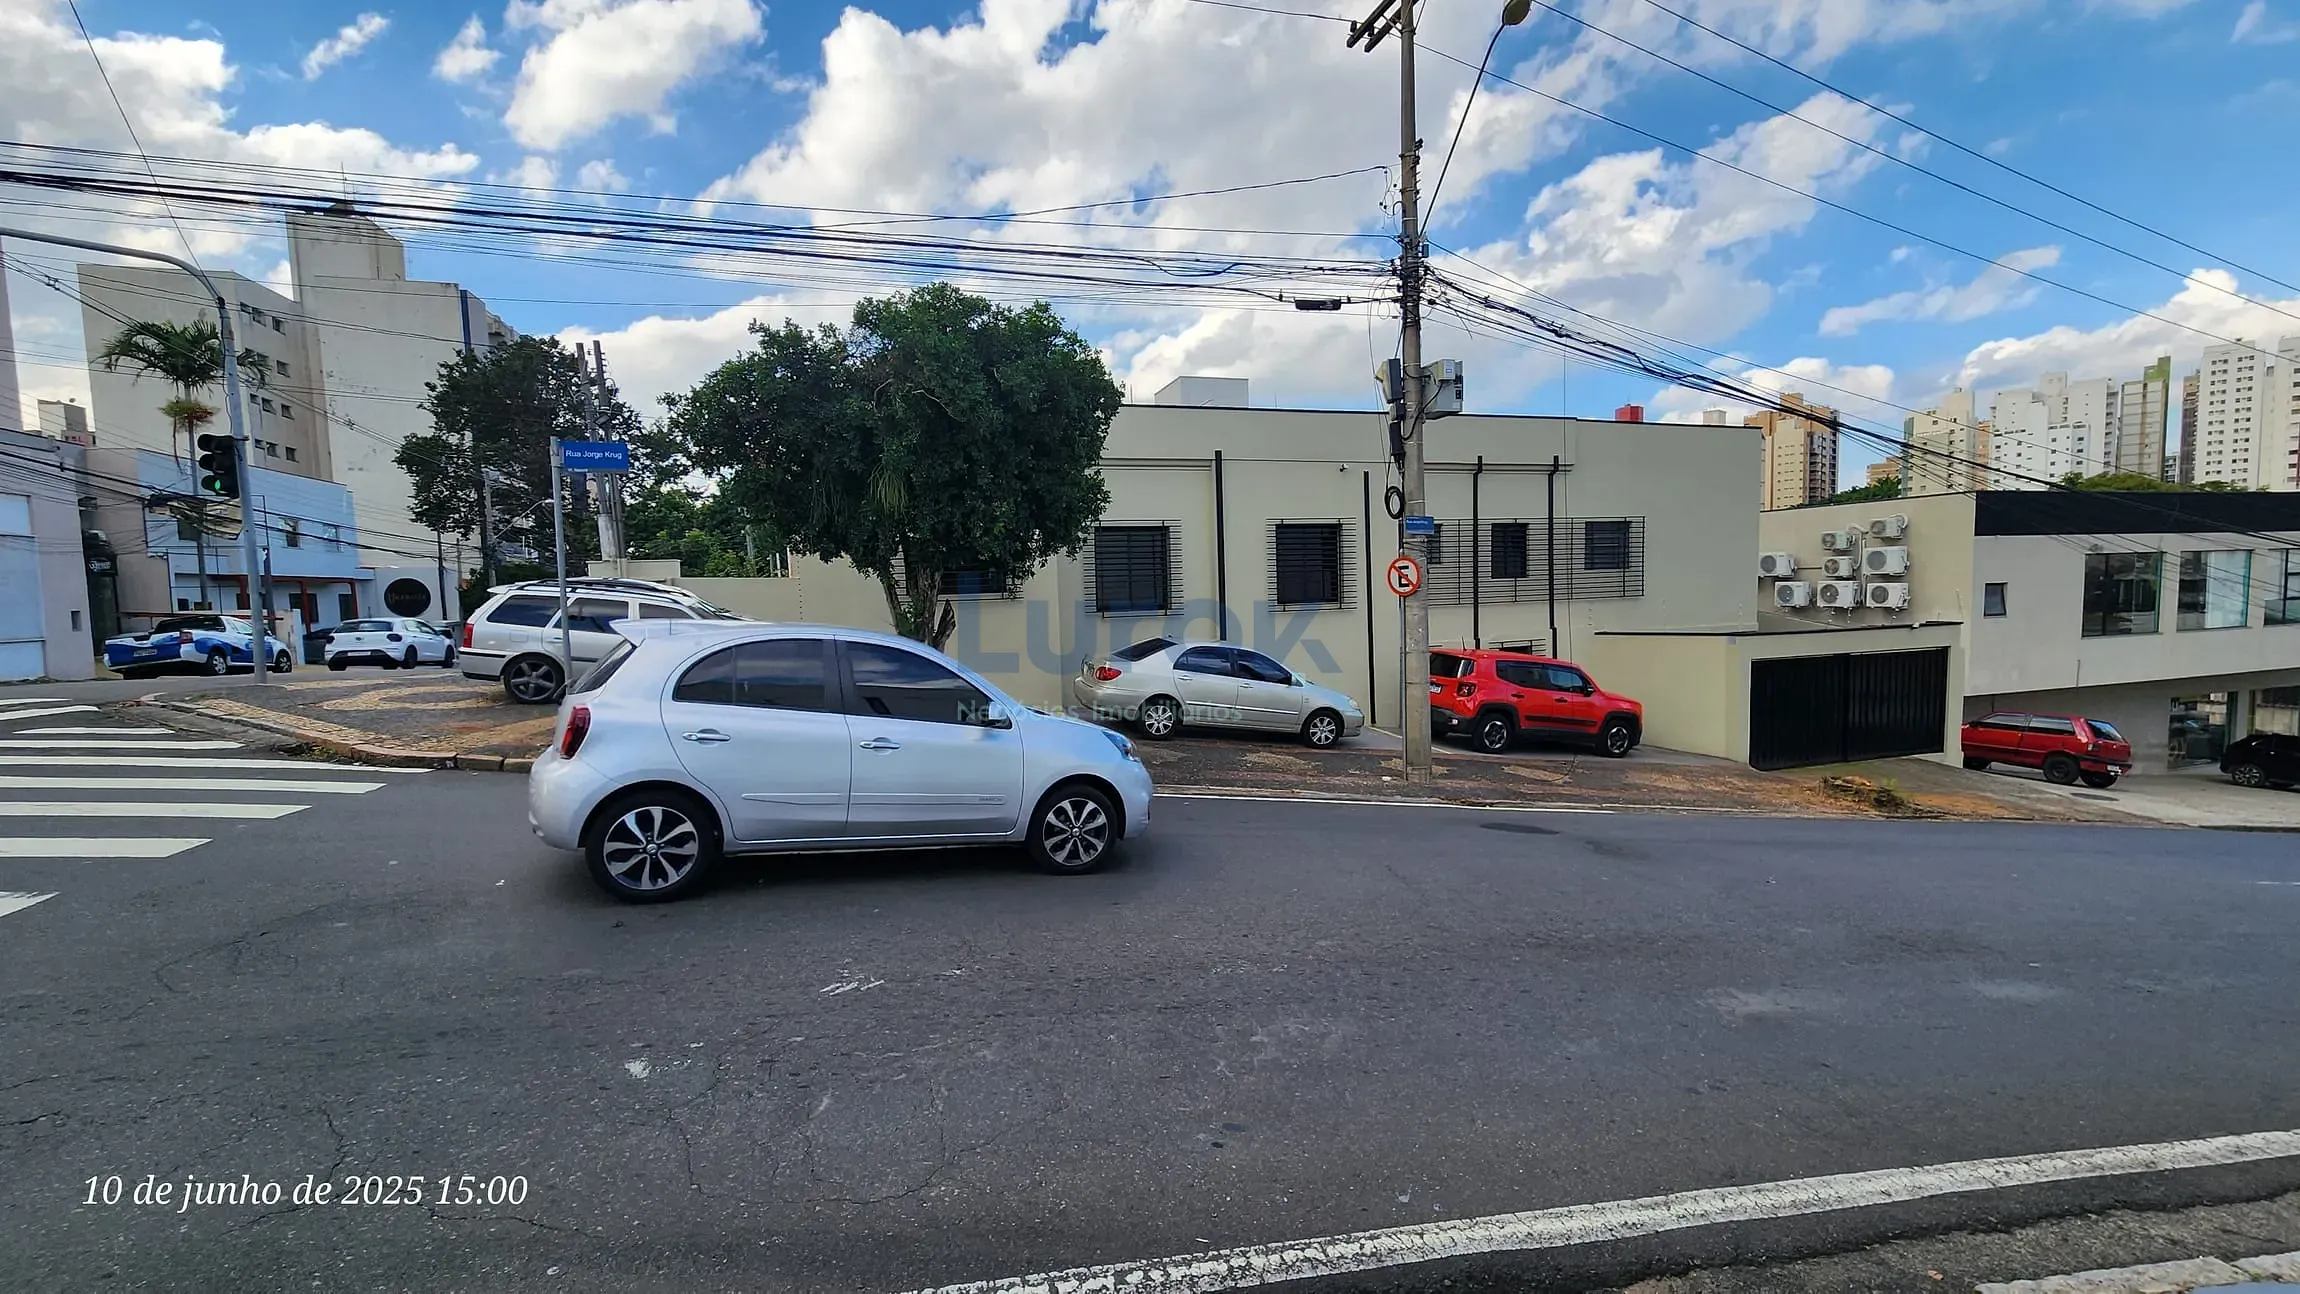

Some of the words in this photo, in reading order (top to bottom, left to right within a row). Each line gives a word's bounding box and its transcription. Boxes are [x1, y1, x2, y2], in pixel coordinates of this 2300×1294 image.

[565, 449, 581, 457] Rua
[583, 450, 603, 460] Jorge
[605, 451, 622, 460] Krug
[1398, 565, 1410, 588] E
